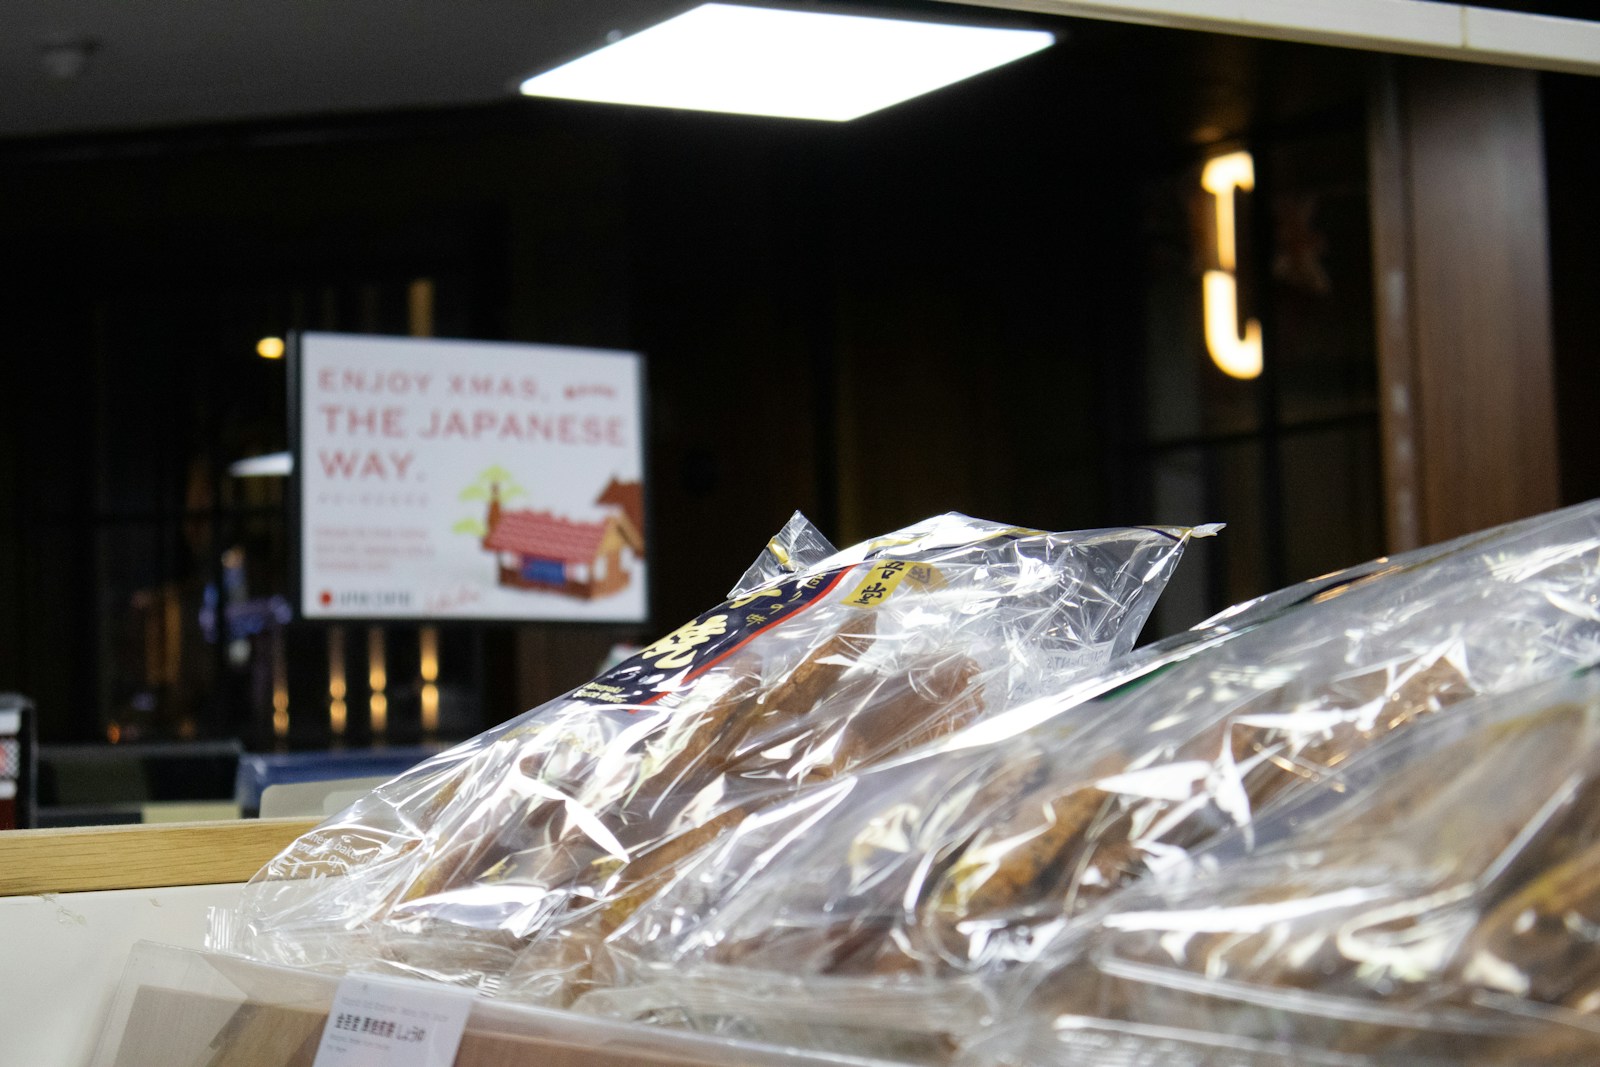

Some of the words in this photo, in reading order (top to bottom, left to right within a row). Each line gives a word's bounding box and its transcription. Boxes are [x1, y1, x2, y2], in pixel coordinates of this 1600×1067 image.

[318, 368, 432, 394] ENJOY
[319, 405, 406, 437] THE
[419, 411, 626, 446] JAPANESE
[319, 451, 424, 482] WAY.
